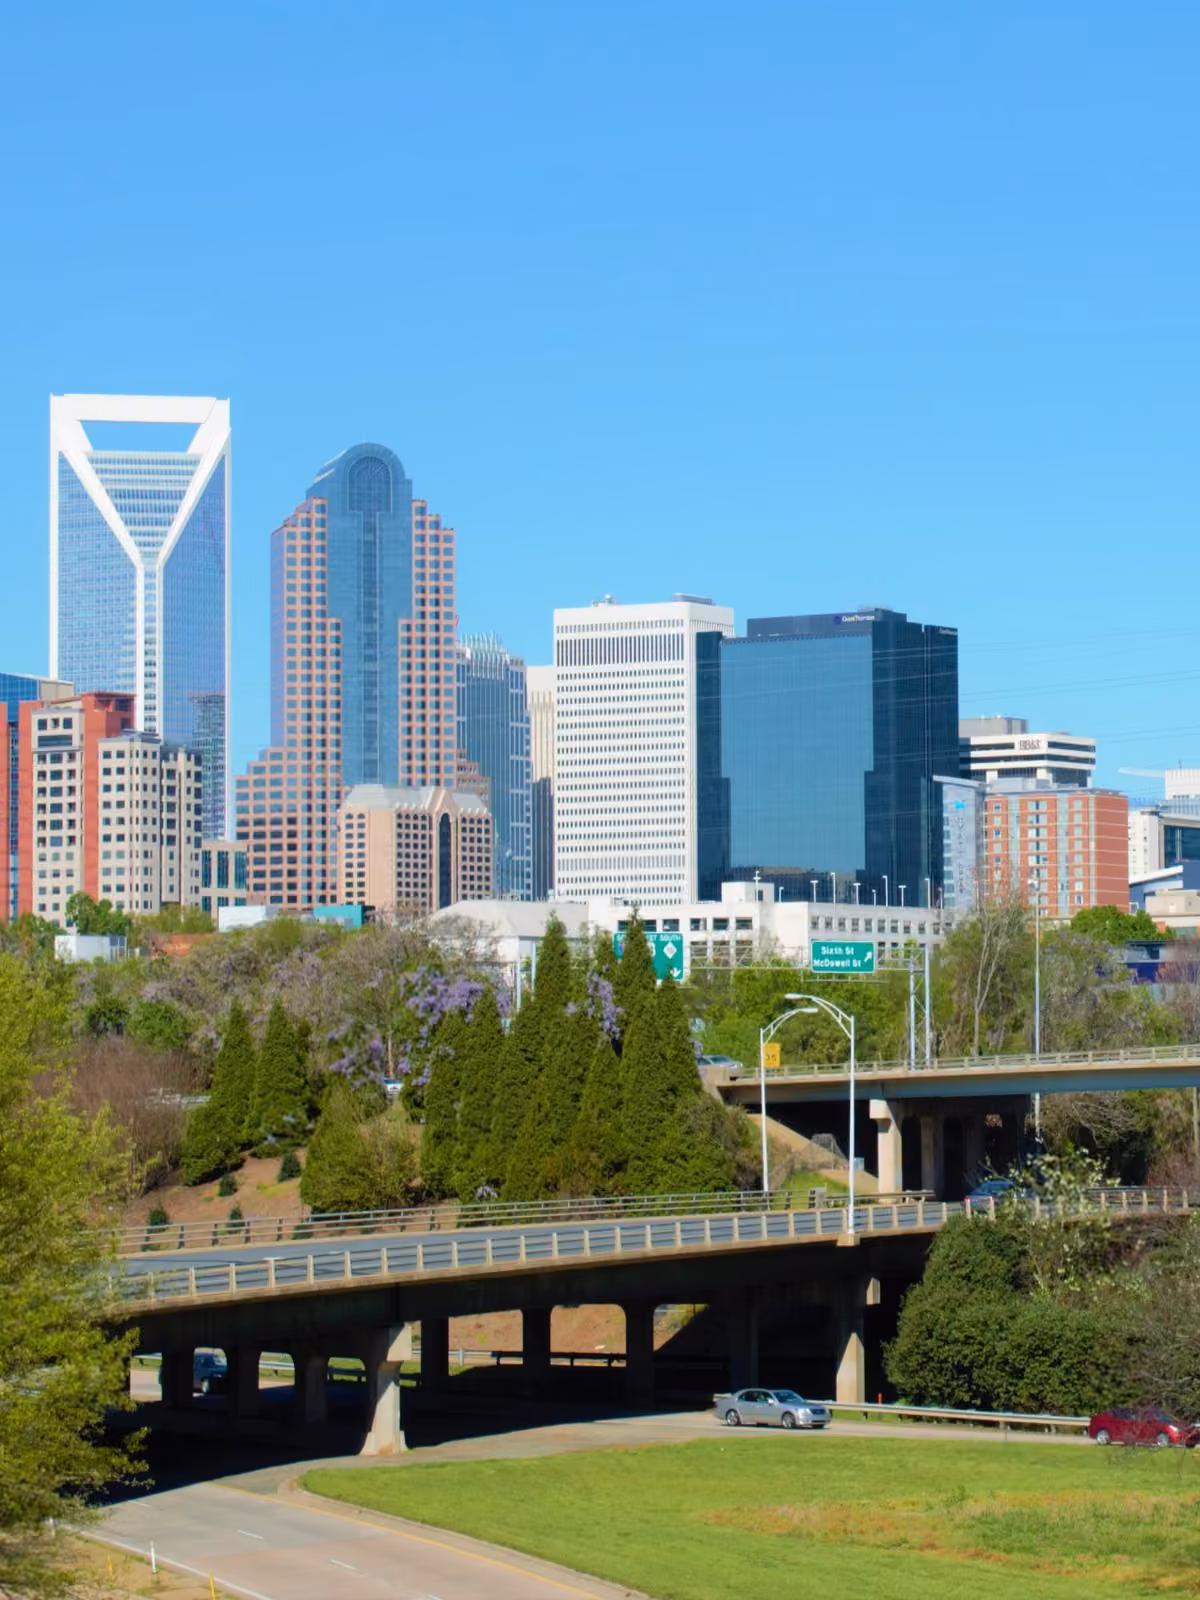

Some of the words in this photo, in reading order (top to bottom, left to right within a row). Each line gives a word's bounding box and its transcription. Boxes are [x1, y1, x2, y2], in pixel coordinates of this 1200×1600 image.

[821, 946, 843, 954] Sixth
[845, 946, 854, 954] St
[813, 958, 850, 967] McDowell
[852, 958, 861, 967] St
